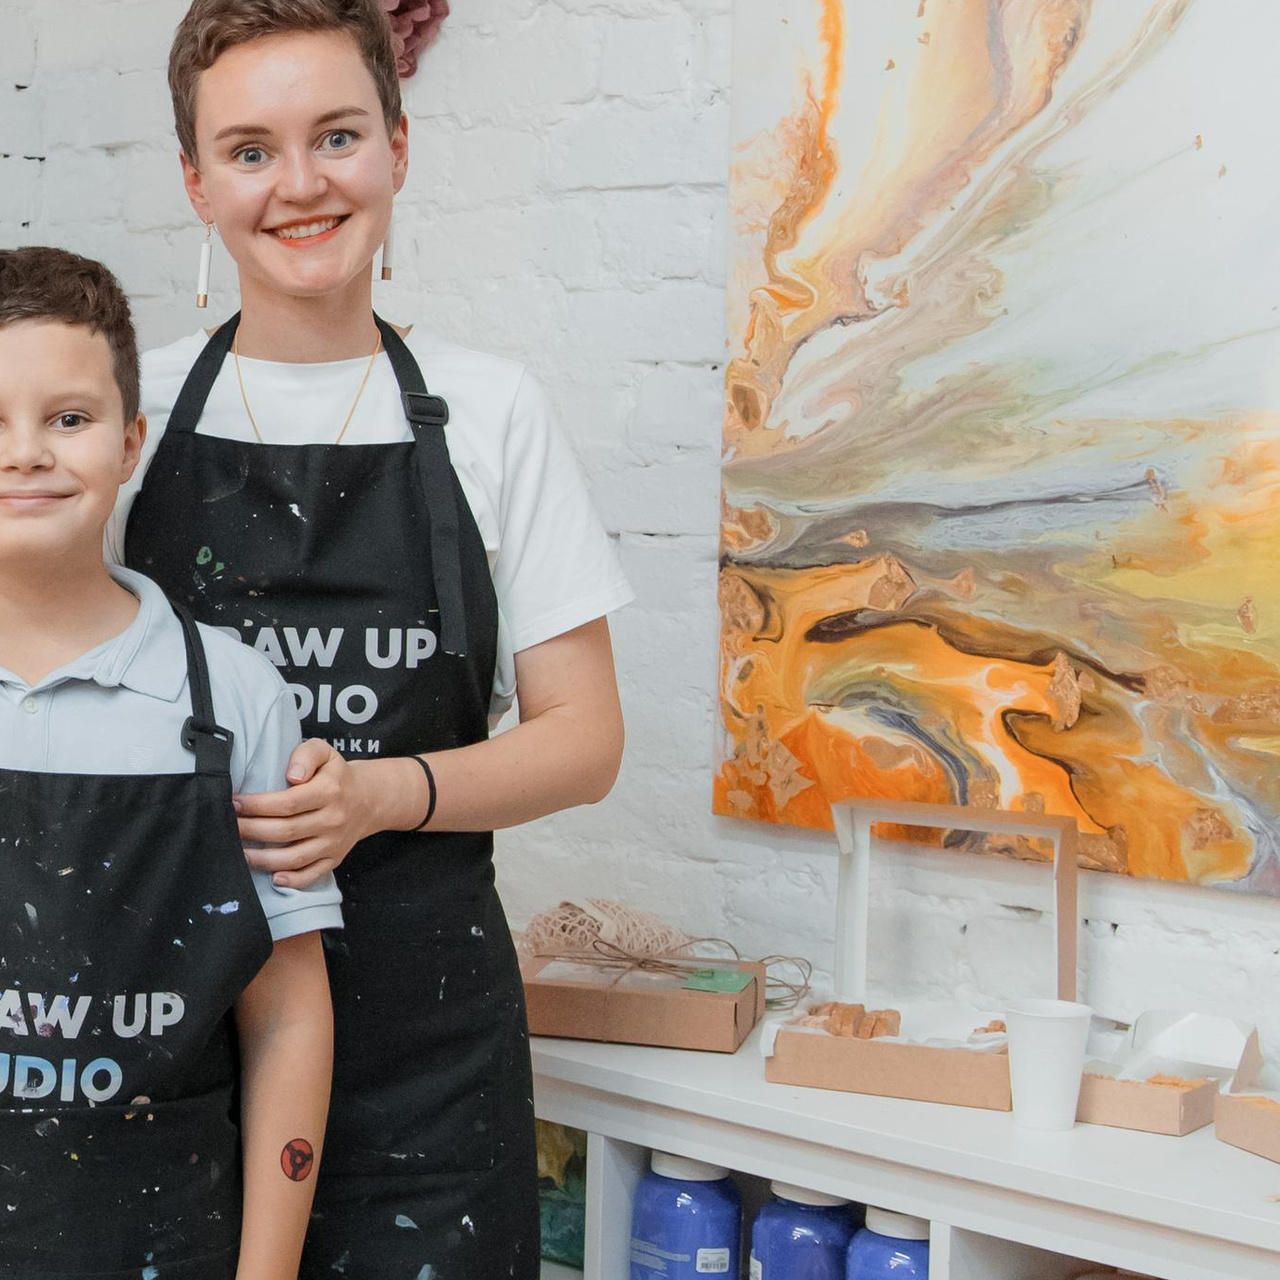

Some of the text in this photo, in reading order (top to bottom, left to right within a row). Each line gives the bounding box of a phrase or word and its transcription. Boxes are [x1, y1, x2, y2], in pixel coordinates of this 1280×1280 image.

[217, 626, 437, 669] AW UP
[324, 737, 380, 754] НКИ
[112, 991, 185, 1038] UP
